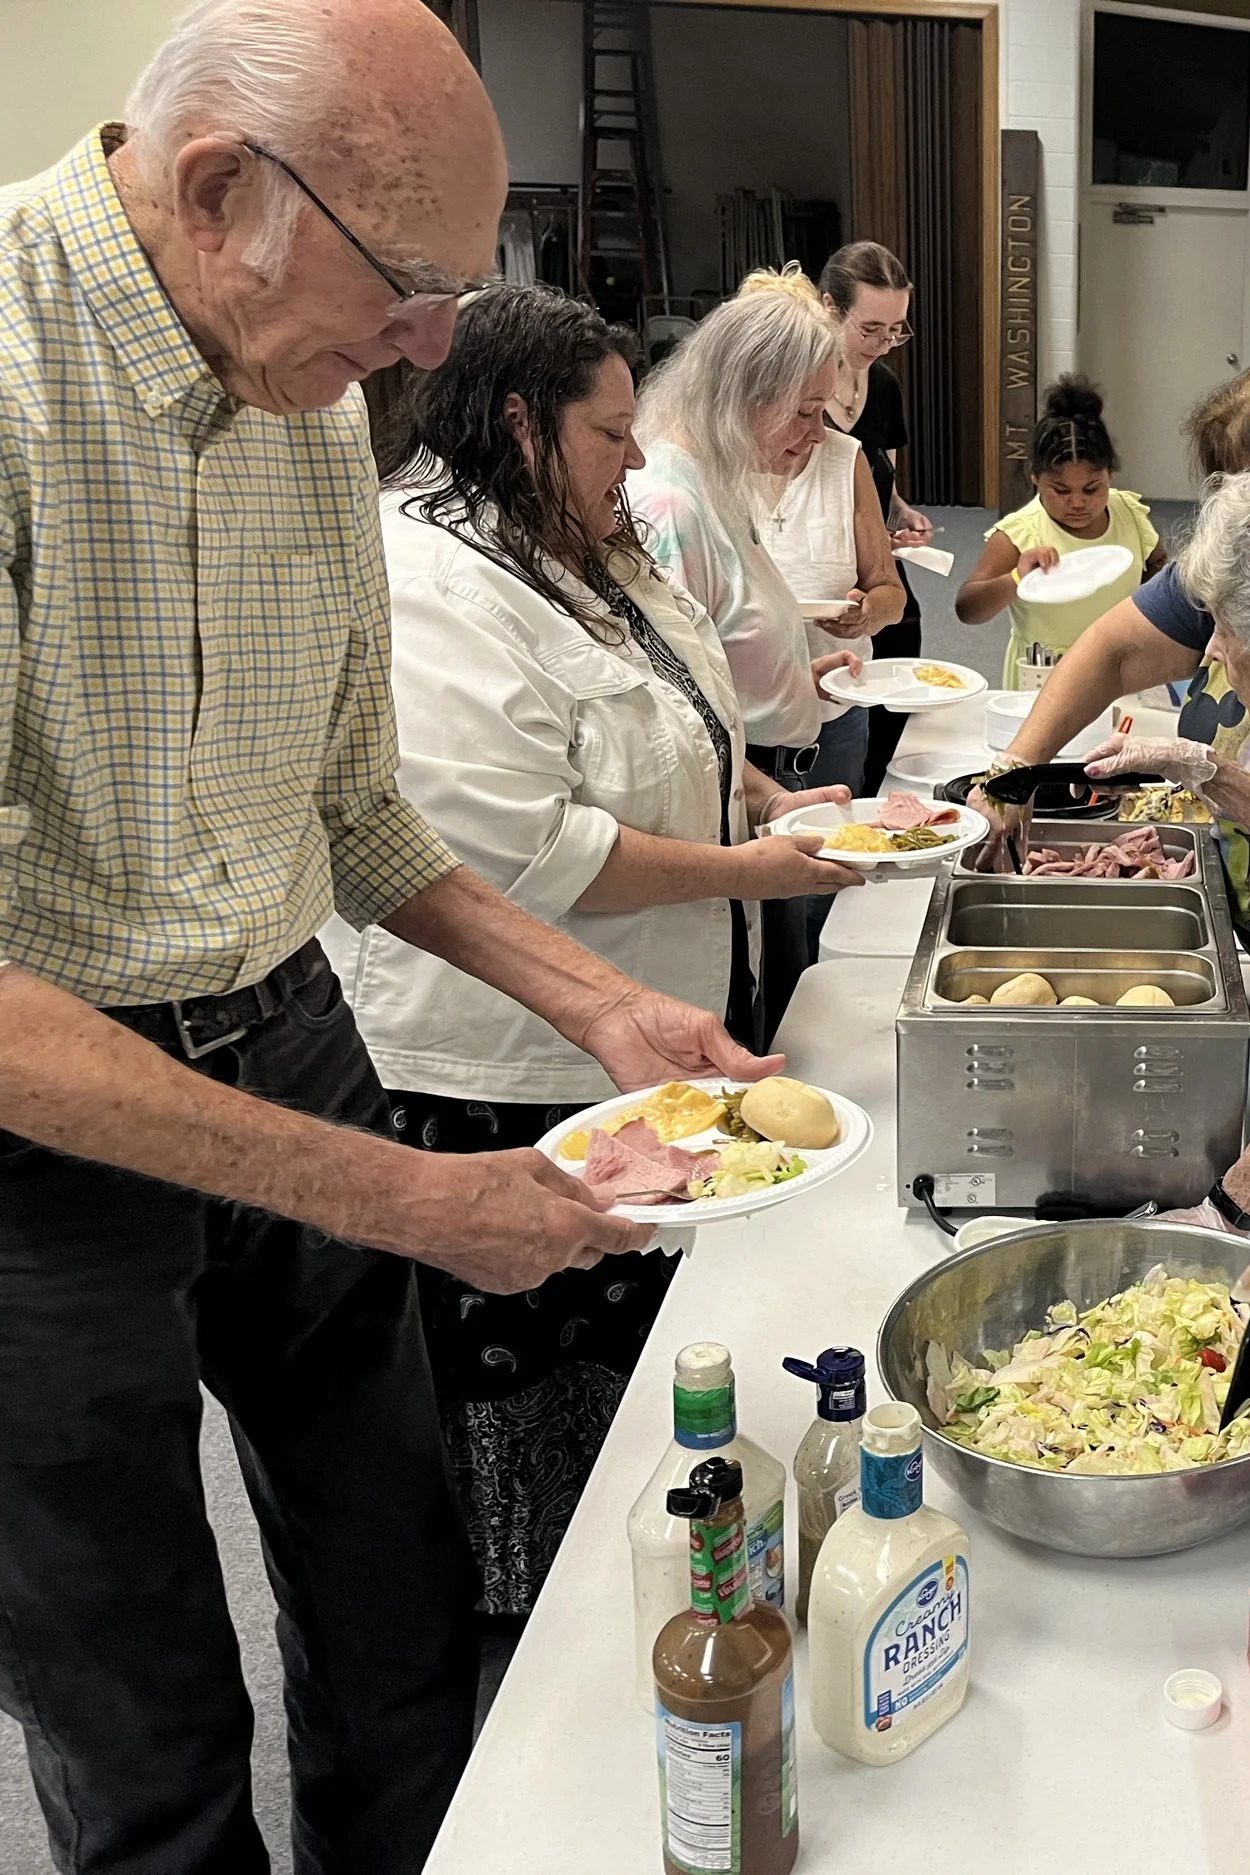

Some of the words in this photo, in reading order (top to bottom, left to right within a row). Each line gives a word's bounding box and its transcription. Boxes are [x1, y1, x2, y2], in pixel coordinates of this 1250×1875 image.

[1006, 195, 1032, 390] WASHINGTON
[1006, 413, 1030, 460] MT.
[884, 1592, 961, 1672] RANCH
[895, 1590, 955, 1637] Creamy
[902, 1629, 950, 1674] DRESSING
[894, 1696, 908, 1711] NO
[715, 1754, 730, 1762] 60
